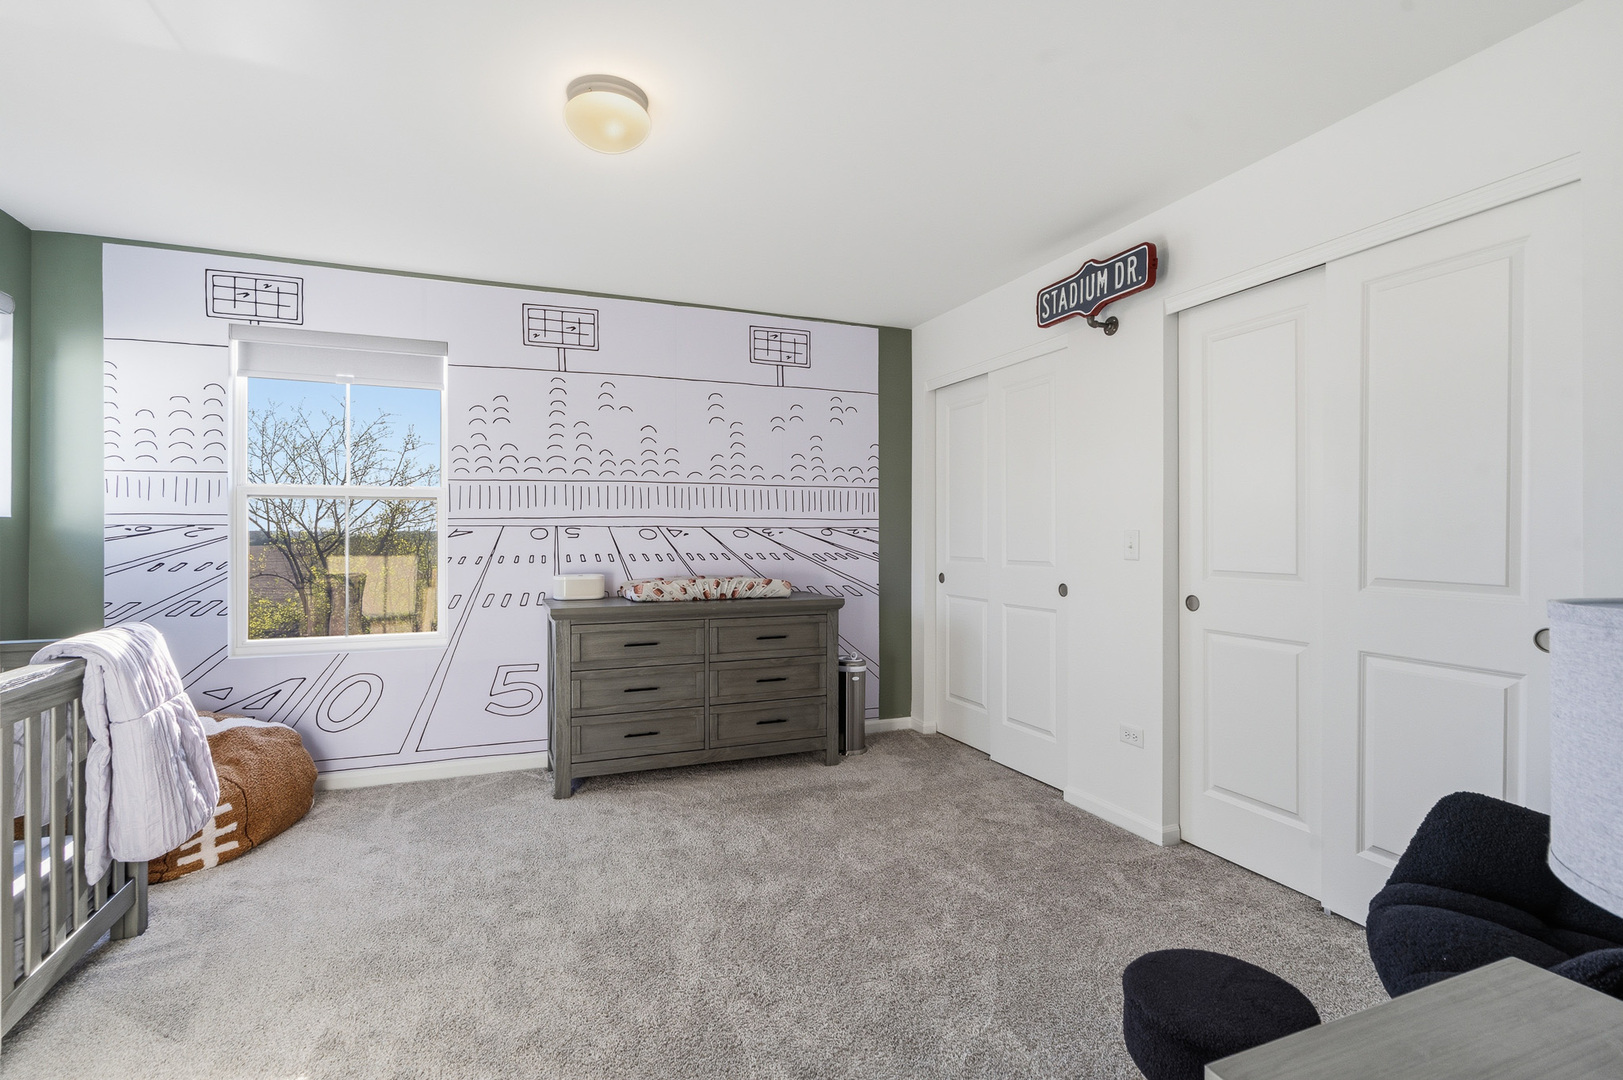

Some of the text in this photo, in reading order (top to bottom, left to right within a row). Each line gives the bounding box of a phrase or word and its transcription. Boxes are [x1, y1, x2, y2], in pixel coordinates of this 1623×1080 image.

[1041, 255, 1142, 319] STADIUM DR.
[485, 663, 544, 717] 5
